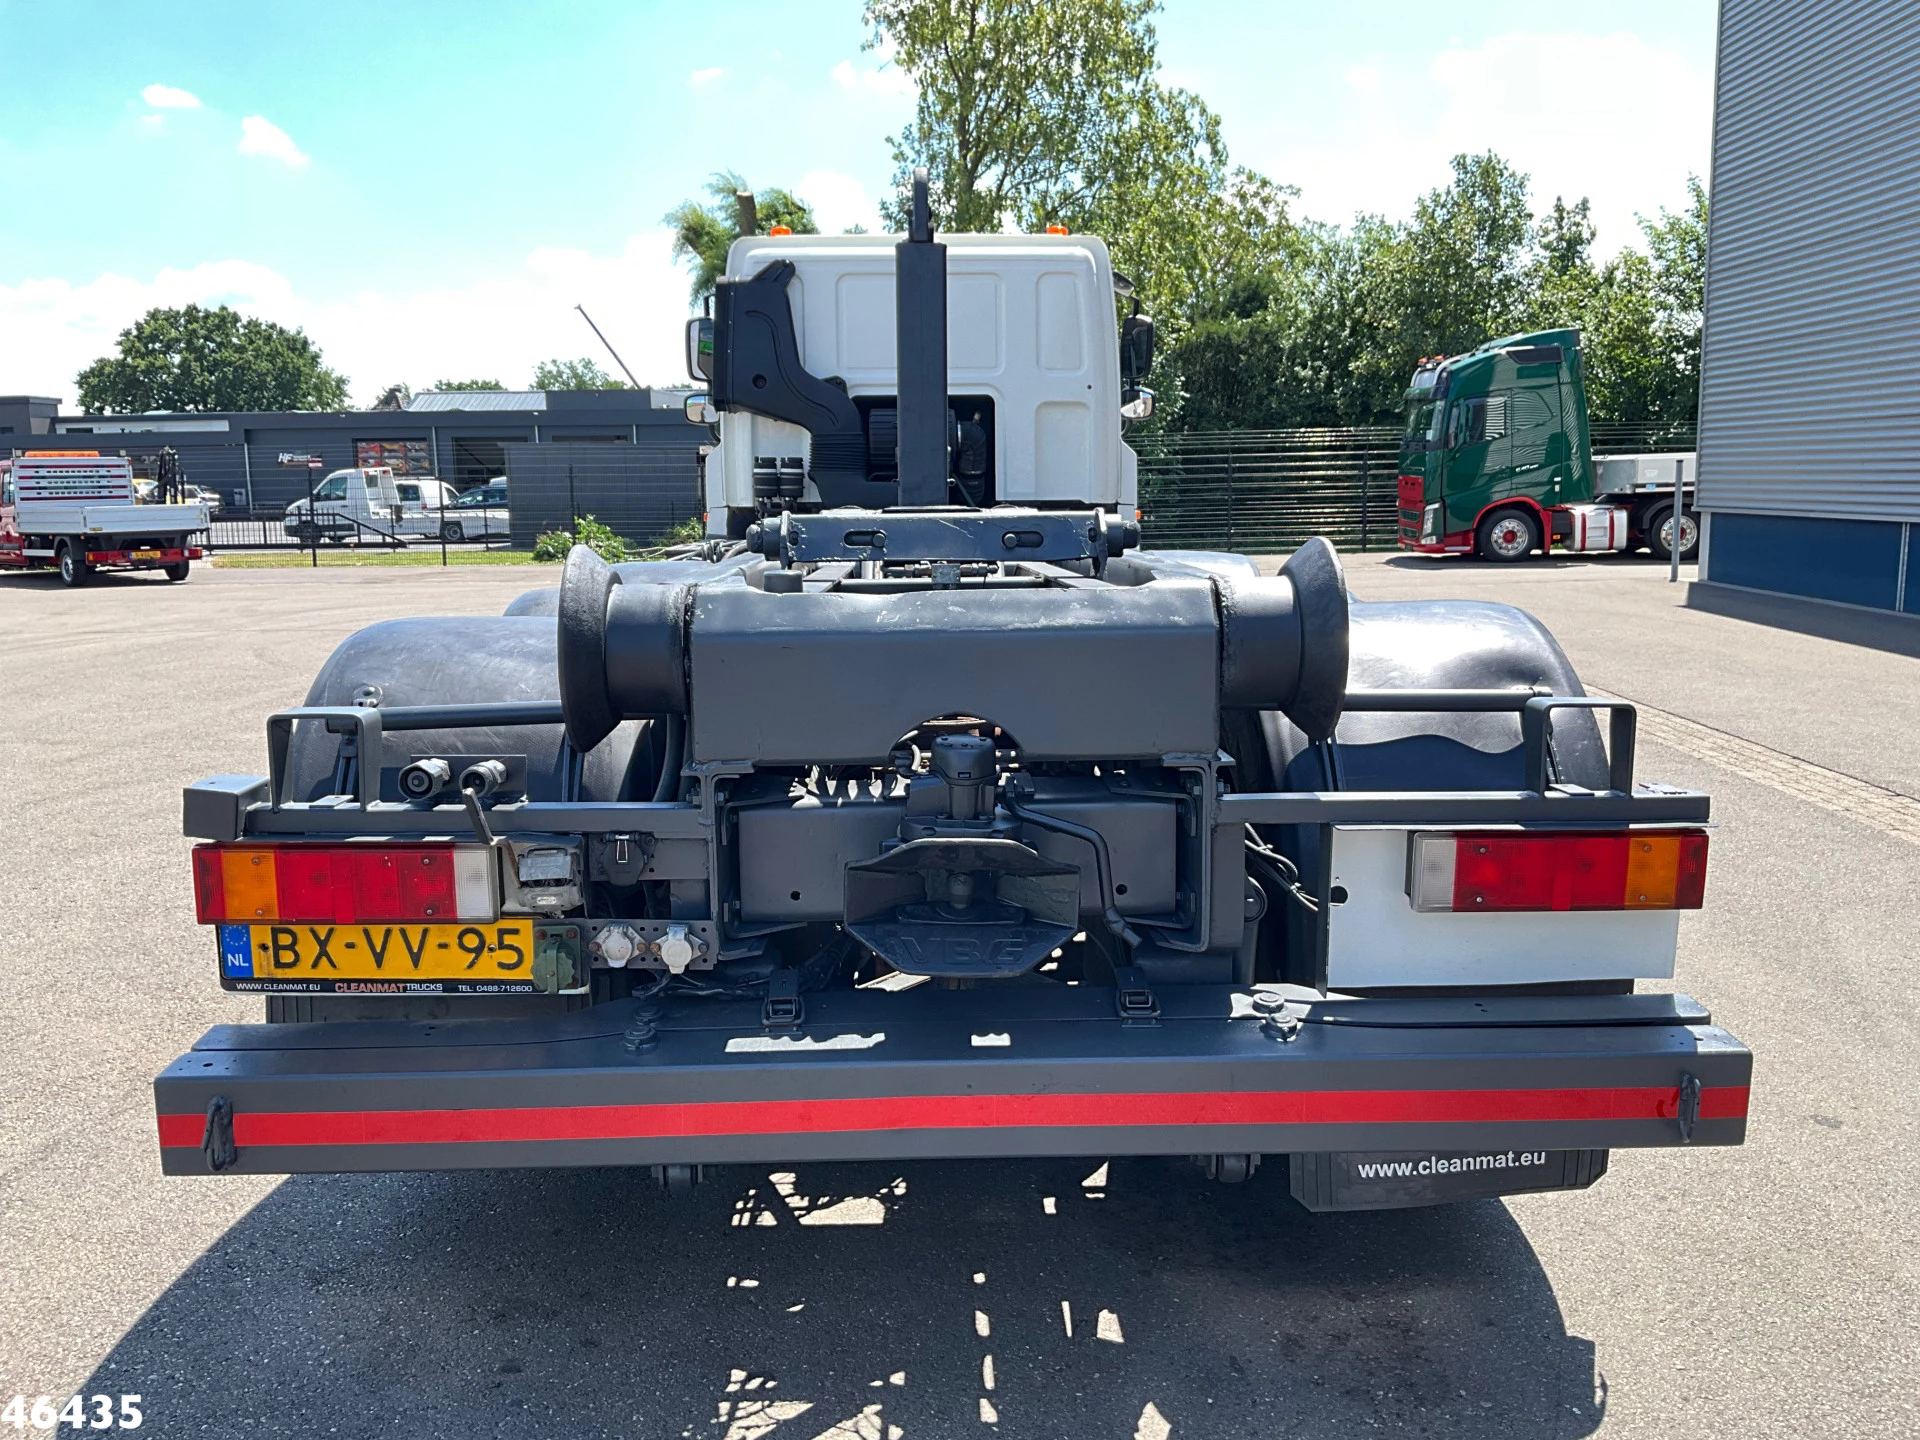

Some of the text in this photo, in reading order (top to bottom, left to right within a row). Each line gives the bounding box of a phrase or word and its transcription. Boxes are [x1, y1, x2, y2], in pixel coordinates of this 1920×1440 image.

[271, 926, 524, 970] BX-VV-95
[228, 954, 249, 967] NL
[236, 983, 320, 991] WWW.CLEANMAT.EU
[457, 984, 474, 992] TEL:
[476, 984, 533, 992] 0488-712600
[1358, 1151, 1546, 1178] www.cleanmat.eu
